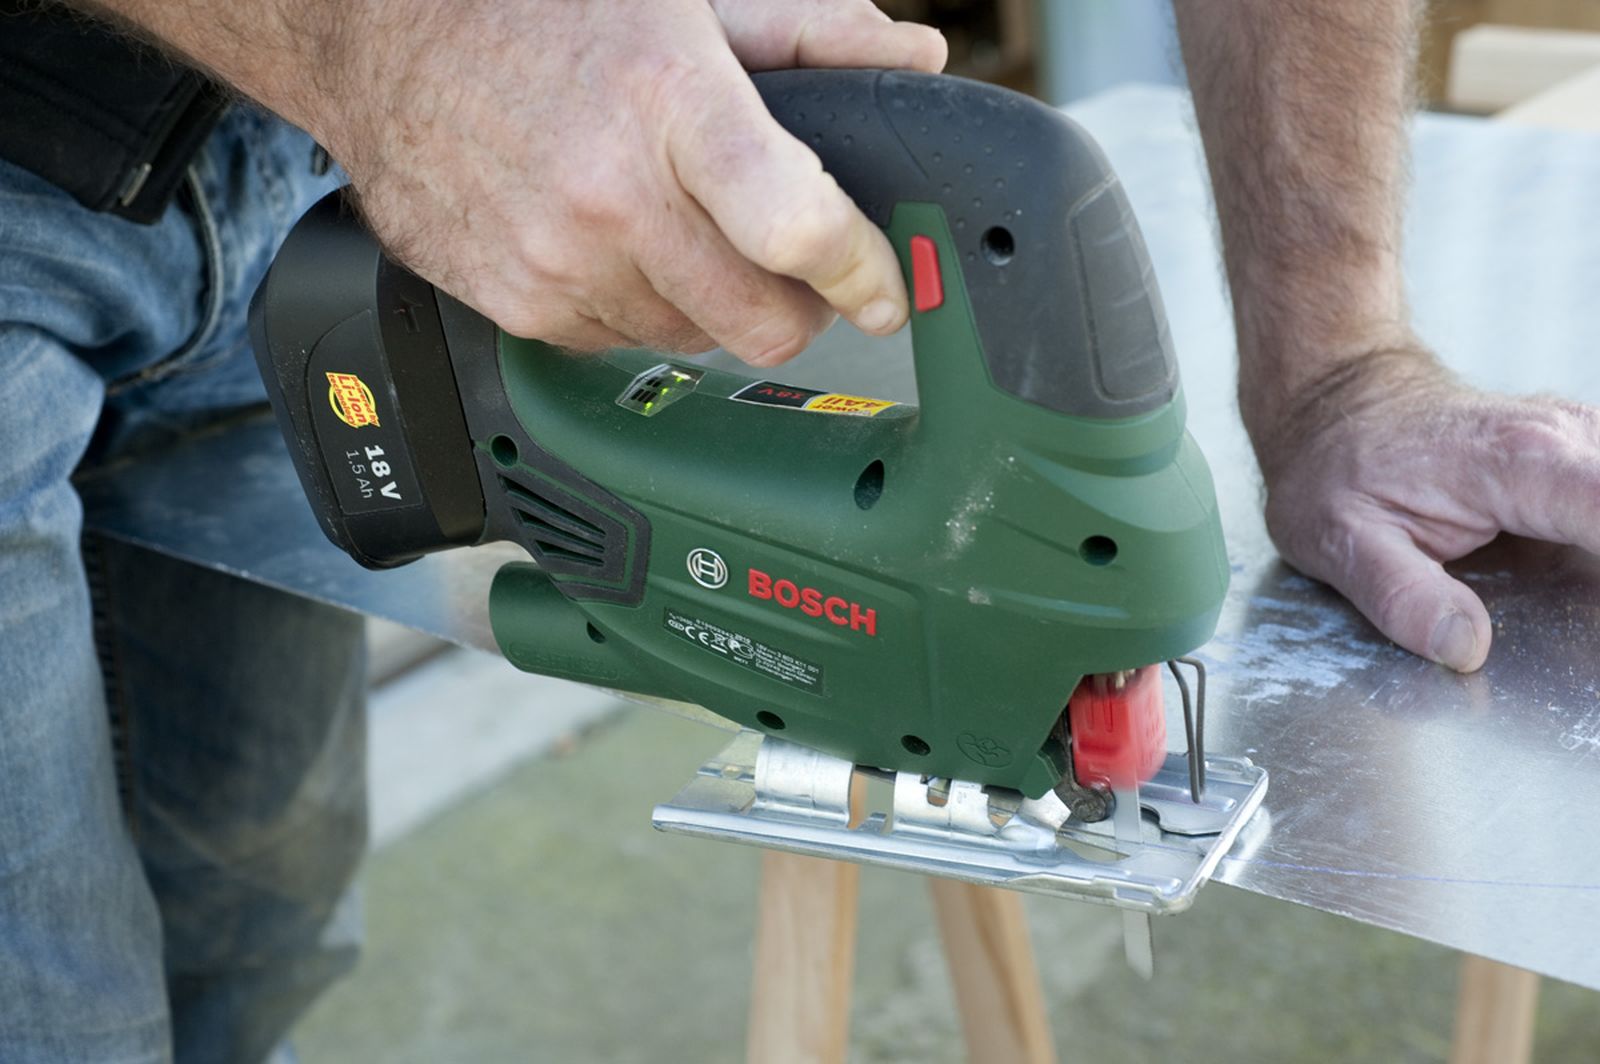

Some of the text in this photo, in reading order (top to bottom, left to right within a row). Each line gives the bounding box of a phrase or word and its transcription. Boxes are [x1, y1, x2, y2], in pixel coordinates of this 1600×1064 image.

[329, 374, 356, 427] technology
[337, 375, 367, 423] Li-Ion
[351, 375, 374, 414] powered
[346, 449, 374, 498] 1.5 Ah
[364, 445, 402, 500] 18 V
[748, 568, 876, 636] BOSCH
